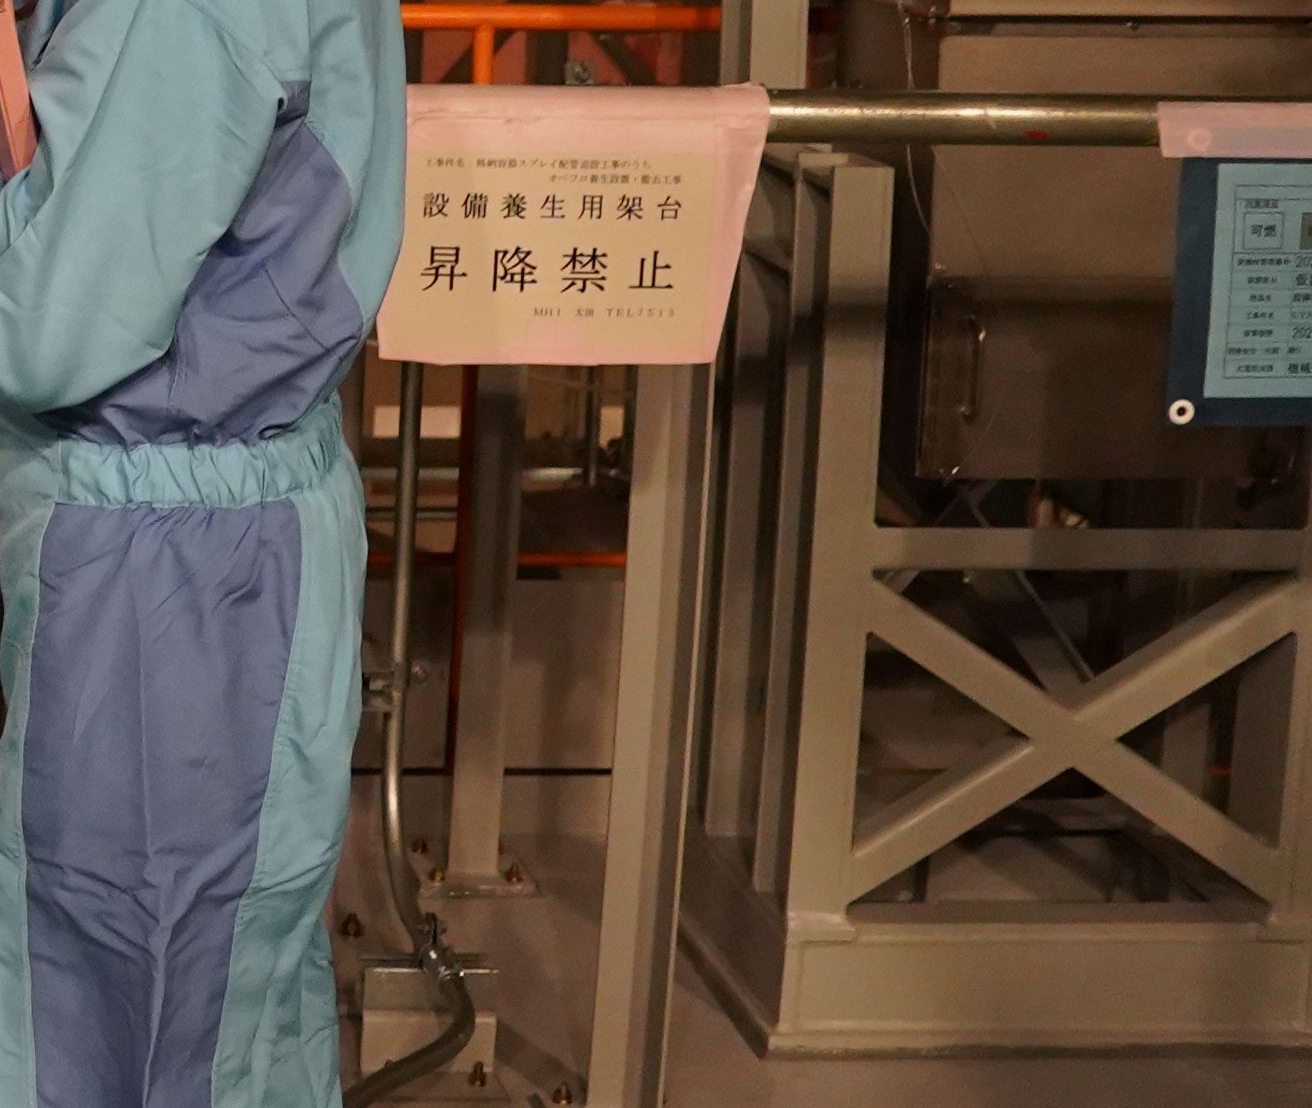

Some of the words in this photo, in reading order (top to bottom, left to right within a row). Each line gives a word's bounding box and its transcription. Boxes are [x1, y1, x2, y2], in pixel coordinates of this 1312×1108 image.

[422, 192, 684, 221] 設備養生用架台
[420, 245, 675, 293] 昇降禁止
